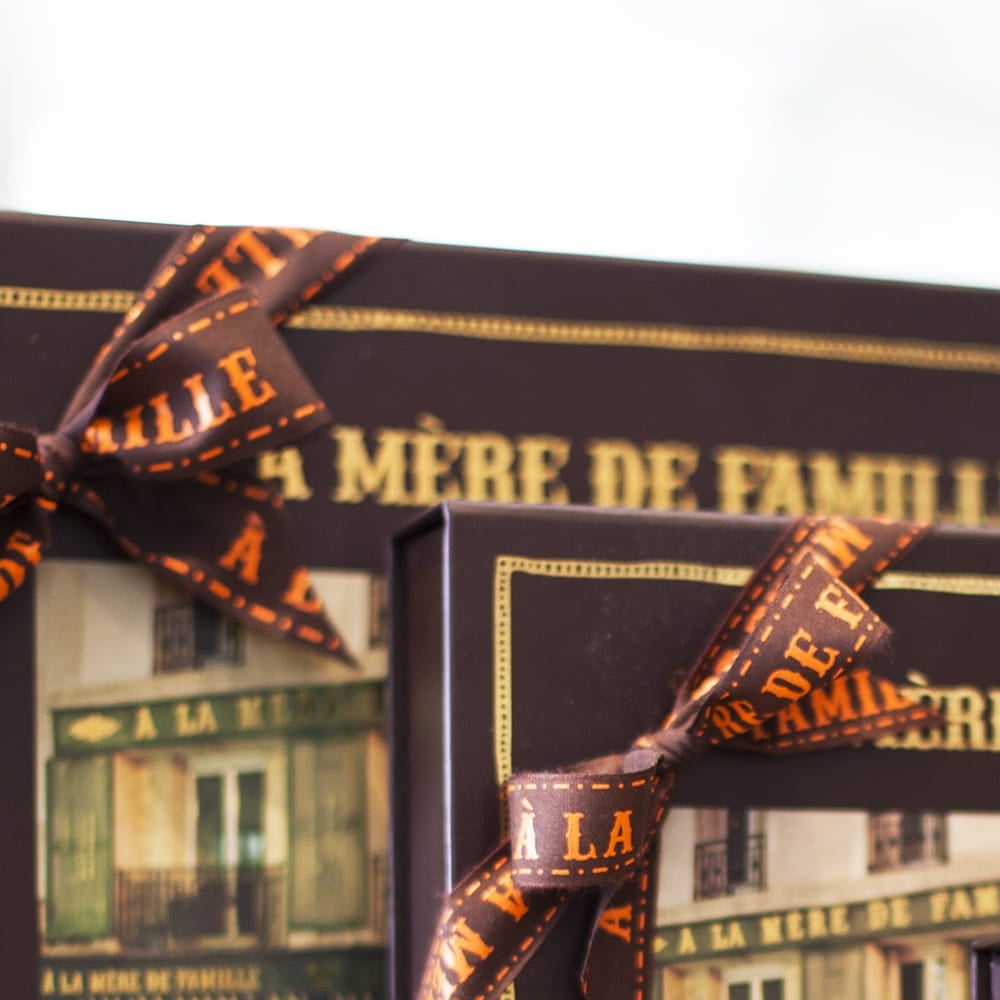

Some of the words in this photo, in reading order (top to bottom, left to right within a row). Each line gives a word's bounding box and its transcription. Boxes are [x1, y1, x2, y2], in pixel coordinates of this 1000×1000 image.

[331, 412, 571, 506] MÈRE
[587, 437, 700, 511] DE
[761, 627, 840, 702] DE
[564, 810, 635, 861] LA
